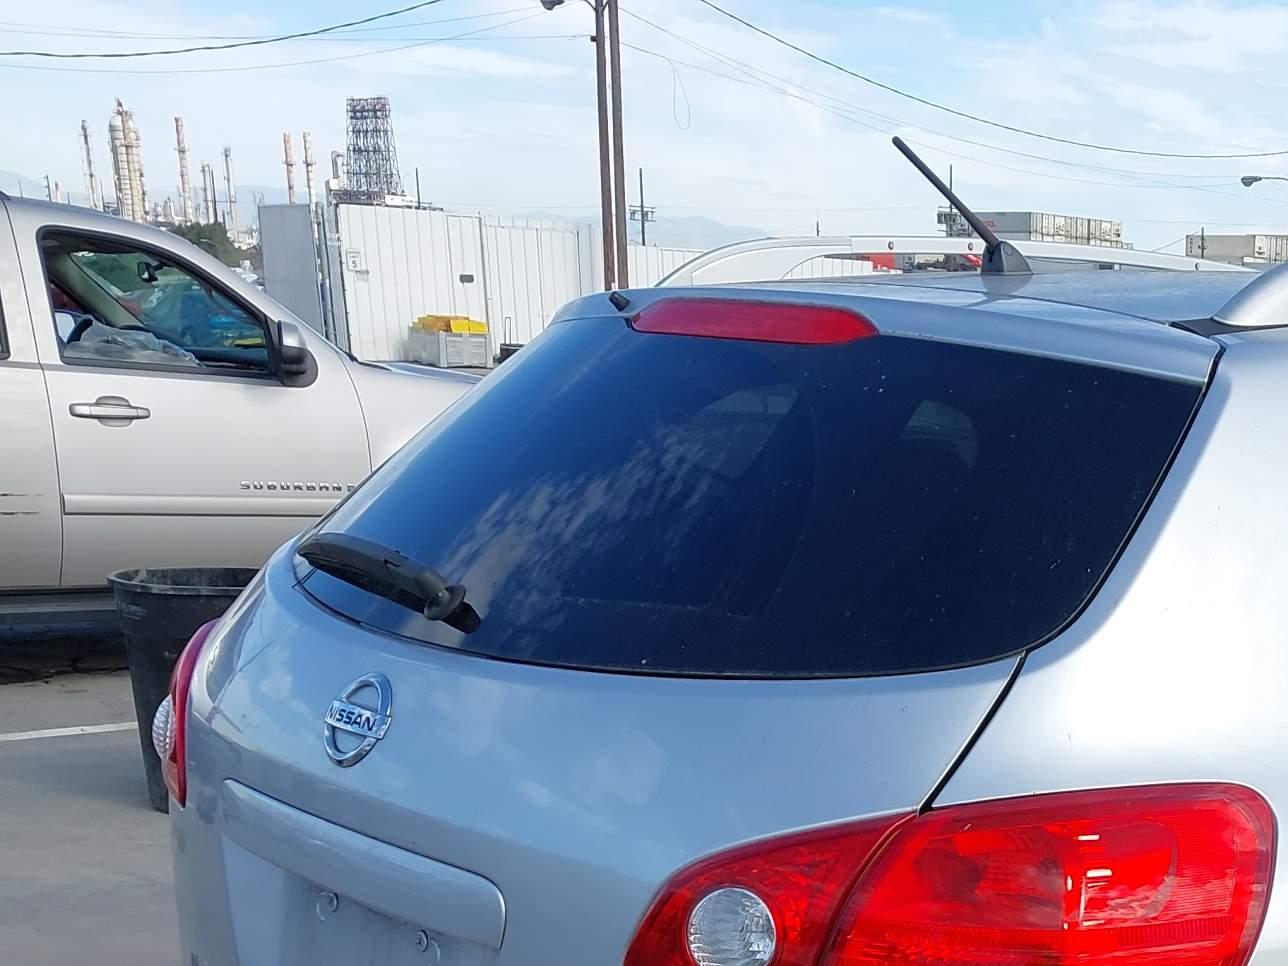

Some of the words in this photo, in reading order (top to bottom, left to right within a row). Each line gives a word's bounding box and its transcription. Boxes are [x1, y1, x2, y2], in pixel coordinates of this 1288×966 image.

[351, 260, 358, 268] 5
[240, 480, 342, 491] SUBURBAN
[325, 703, 377, 732] NISSAN
